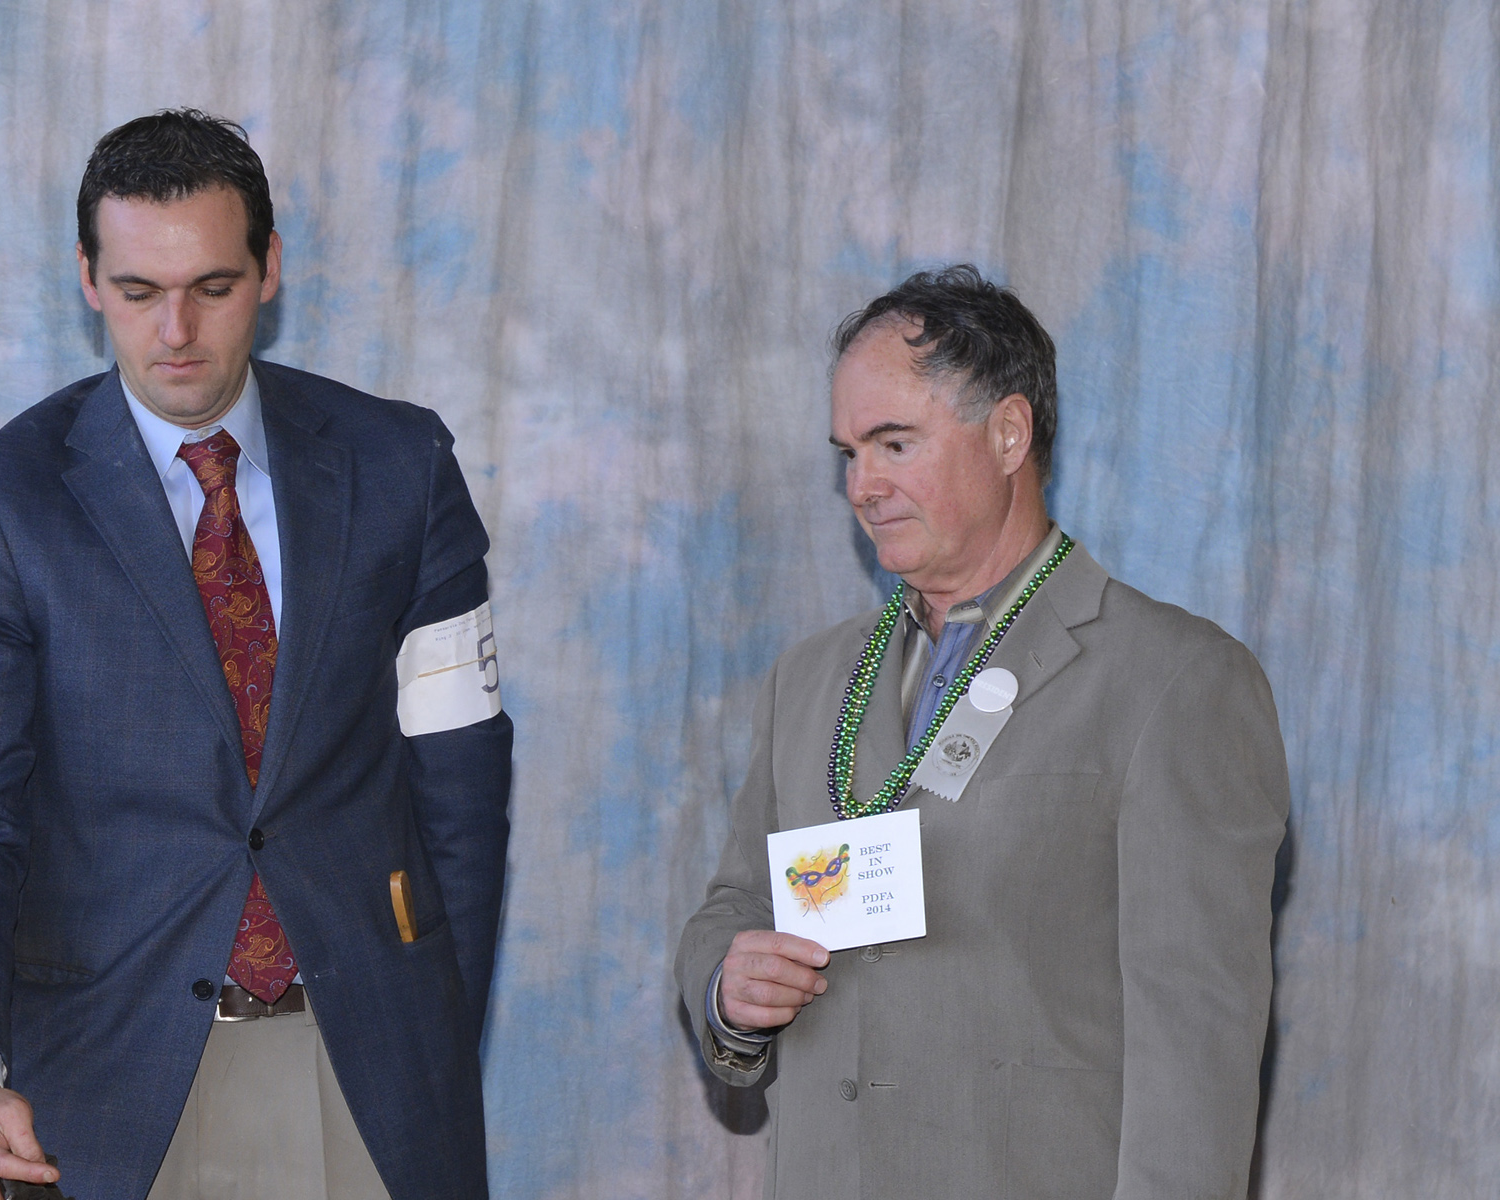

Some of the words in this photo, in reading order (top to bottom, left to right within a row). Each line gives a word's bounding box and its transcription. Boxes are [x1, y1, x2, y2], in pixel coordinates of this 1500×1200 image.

[859, 842, 891, 856] BEST
[869, 856, 882, 867] IN
[857, 866, 894, 880] SHOW
[862, 891, 894, 904] PDFA
[866, 904, 891, 915] 2014
